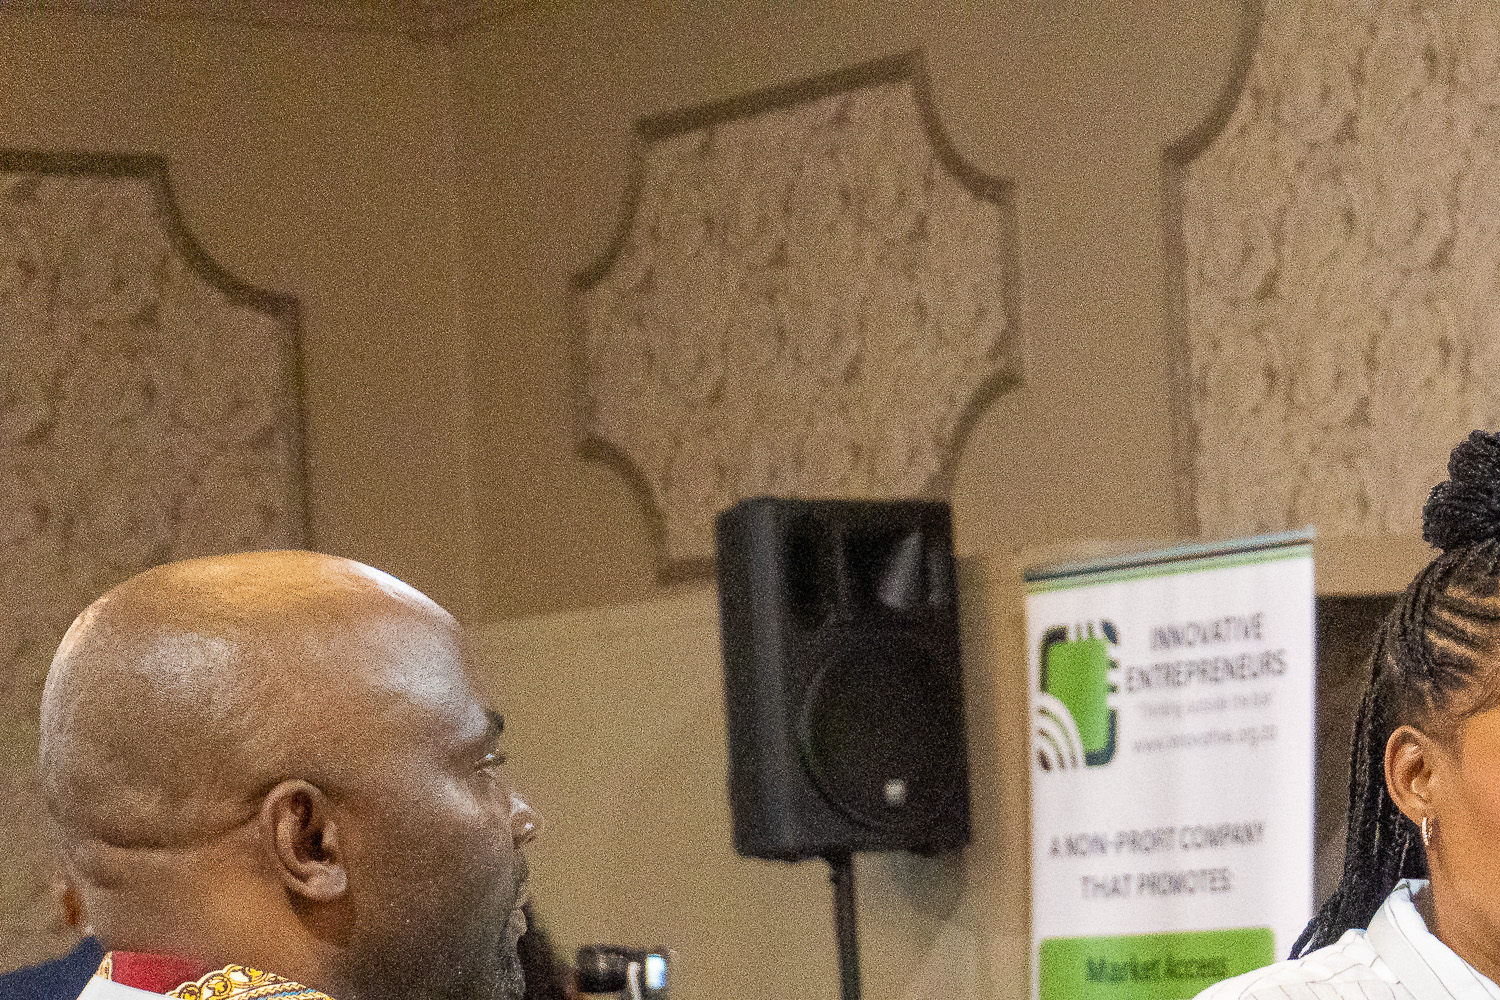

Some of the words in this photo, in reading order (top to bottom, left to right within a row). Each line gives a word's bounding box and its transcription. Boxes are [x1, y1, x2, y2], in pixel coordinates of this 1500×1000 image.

[1150, 612, 1264, 650] INNOVATIVE
[1126, 650, 1287, 693] ENTREPRENEURS
[1049, 835, 1061, 858] A
[1064, 825, 1176, 857] NON-PROFIT
[1179, 817, 1265, 852] COMPANY
[1080, 872, 1131, 899] THAT
[1086, 955, 1161, 984] Market
[1163, 954, 1229, 980] Access
